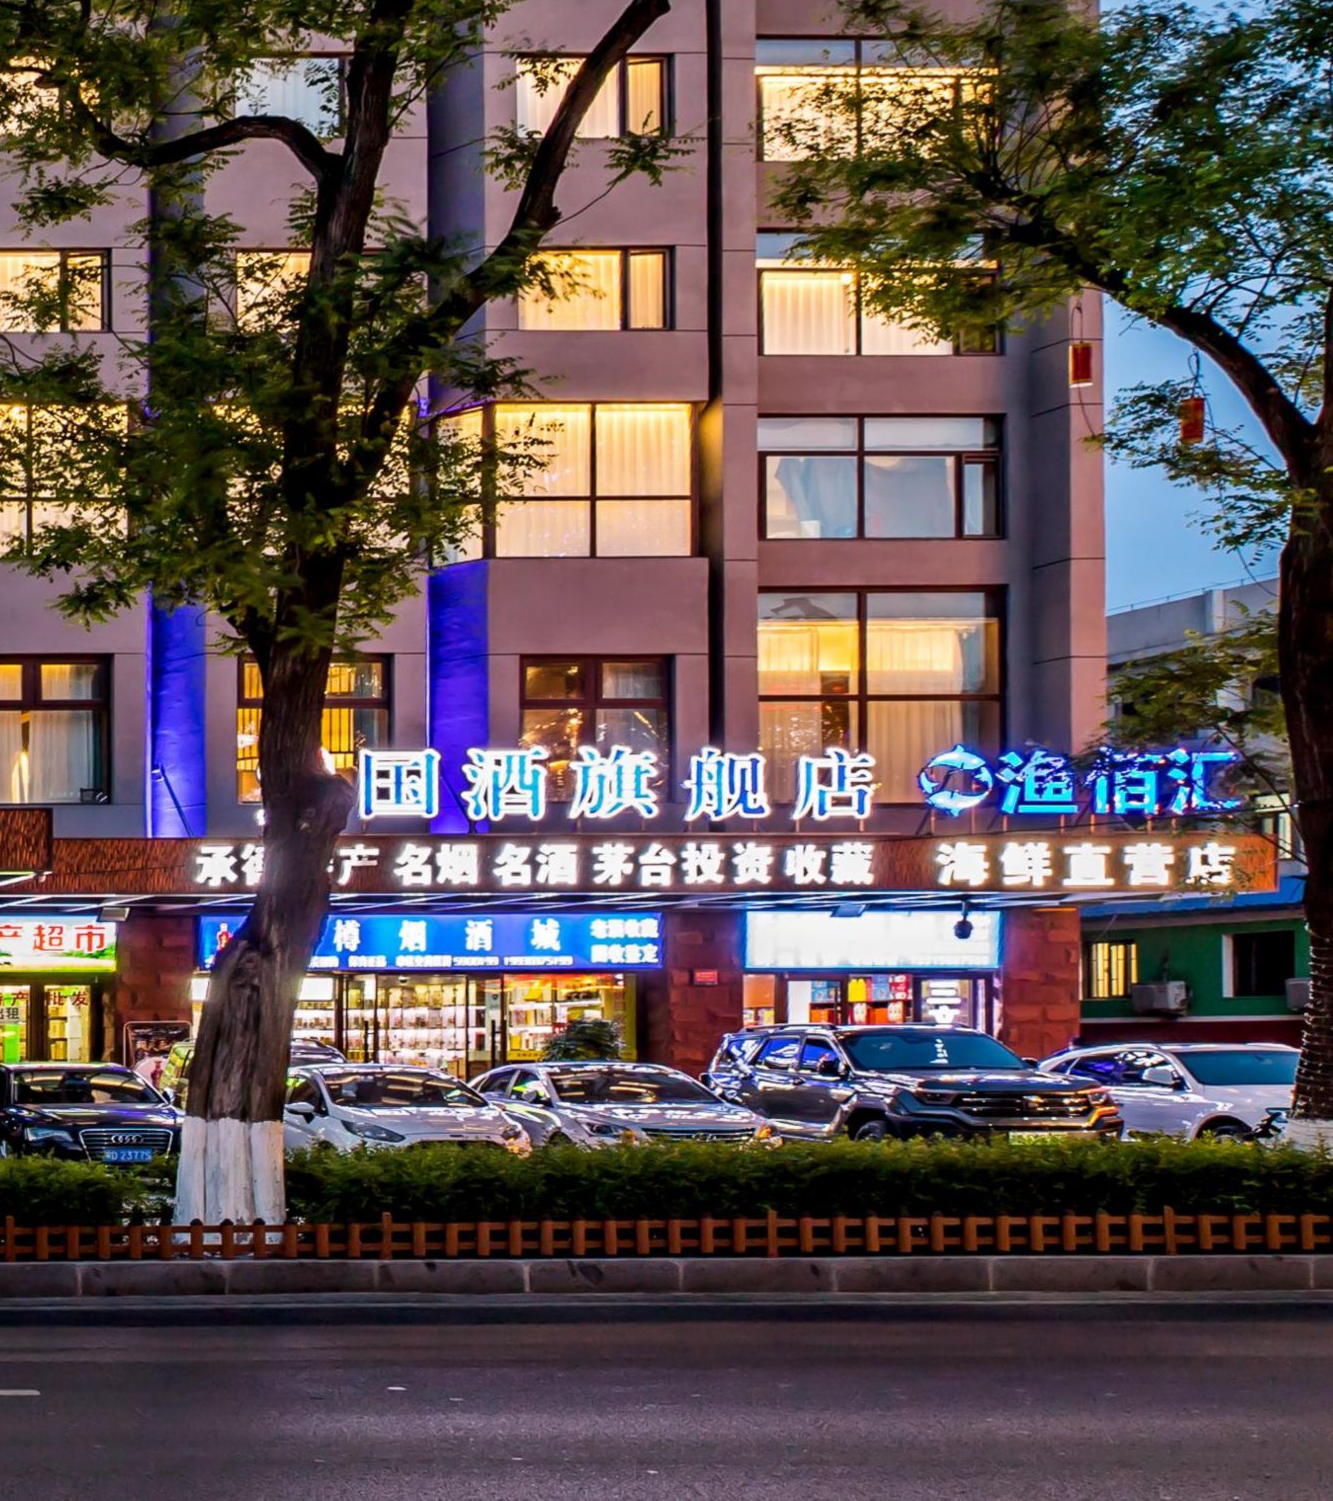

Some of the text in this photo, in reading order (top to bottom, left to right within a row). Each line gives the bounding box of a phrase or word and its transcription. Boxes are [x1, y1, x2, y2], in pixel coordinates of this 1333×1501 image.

[256, 743, 877, 821] 国酒旗舰店
[392, 843, 479, 886] 名烟
[492, 843, 578, 886] 名酒
[935, 841, 1237, 887] 海鲜直营店
